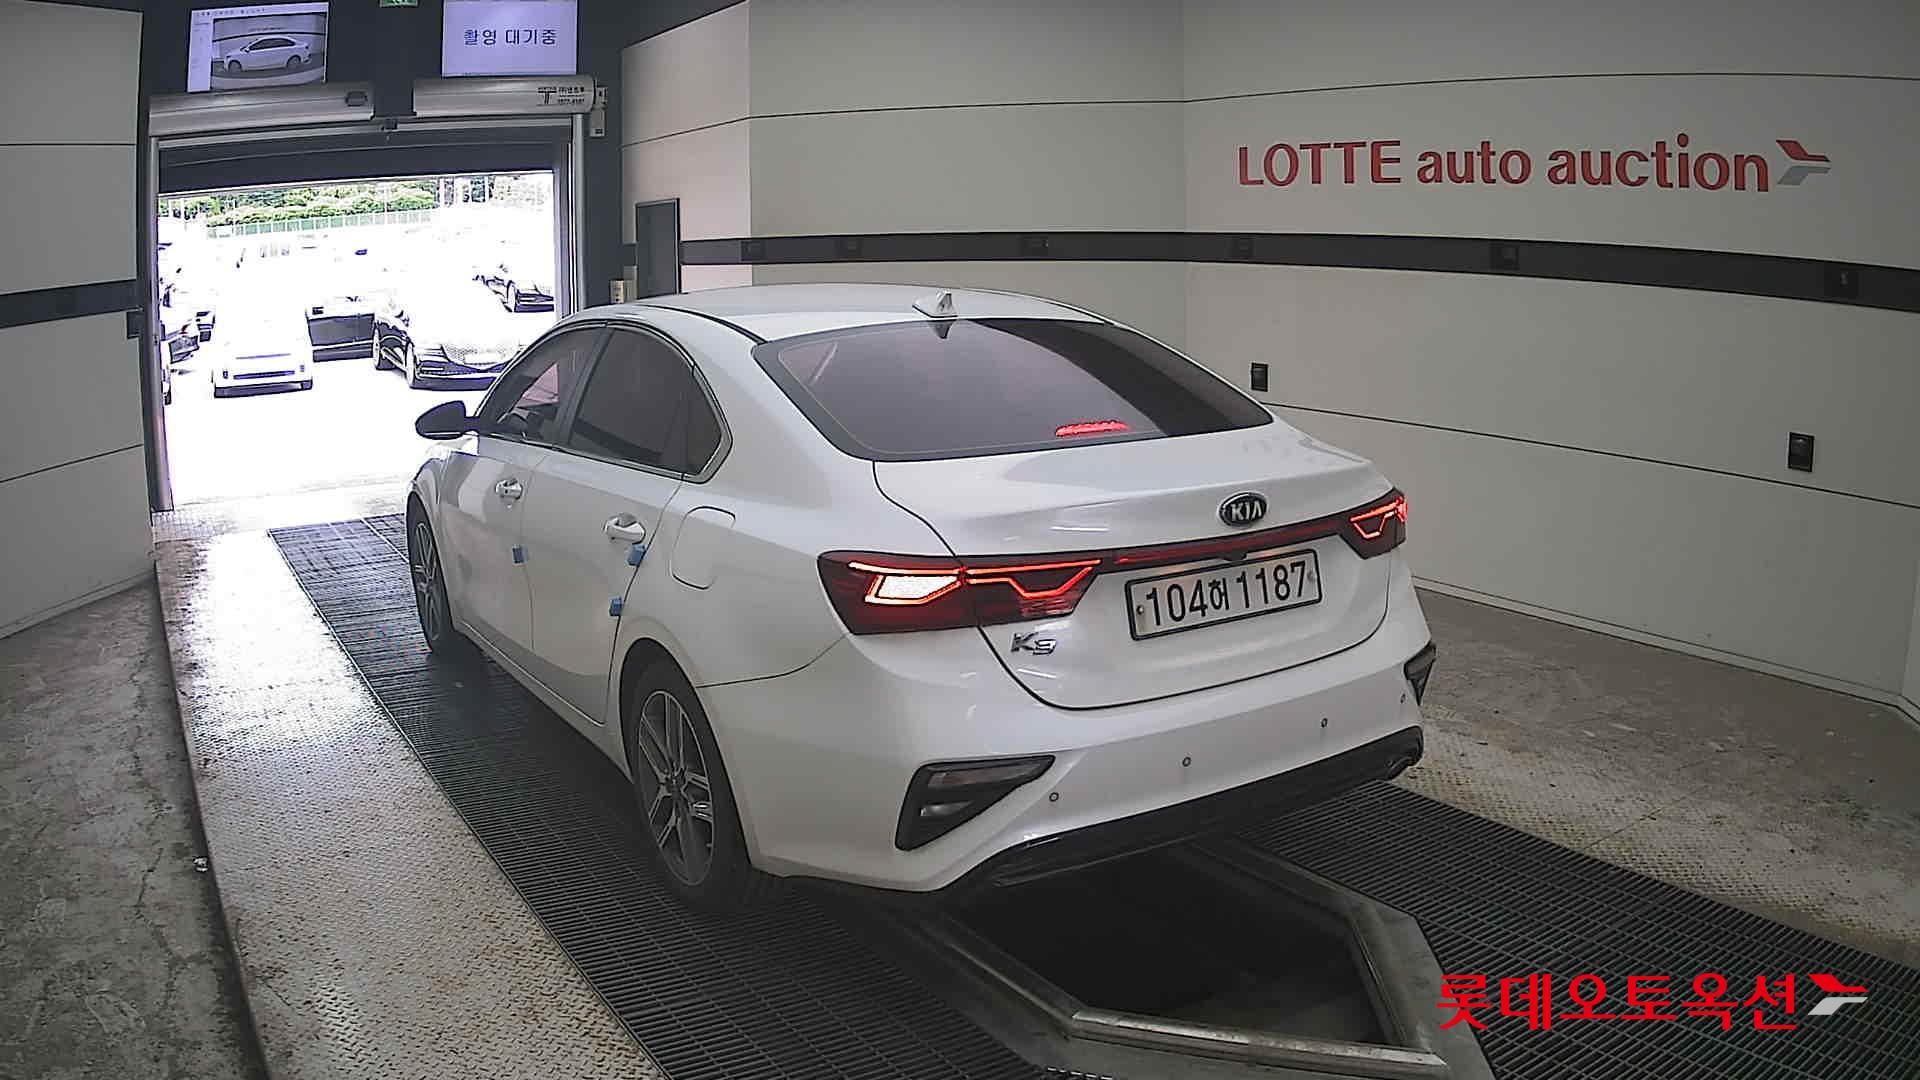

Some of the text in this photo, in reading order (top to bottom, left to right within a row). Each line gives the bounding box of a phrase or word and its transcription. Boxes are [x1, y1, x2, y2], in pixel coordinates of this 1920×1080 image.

[505, 29, 557, 46] 대기중
[1238, 132, 1770, 192] LOTTE auto auction
